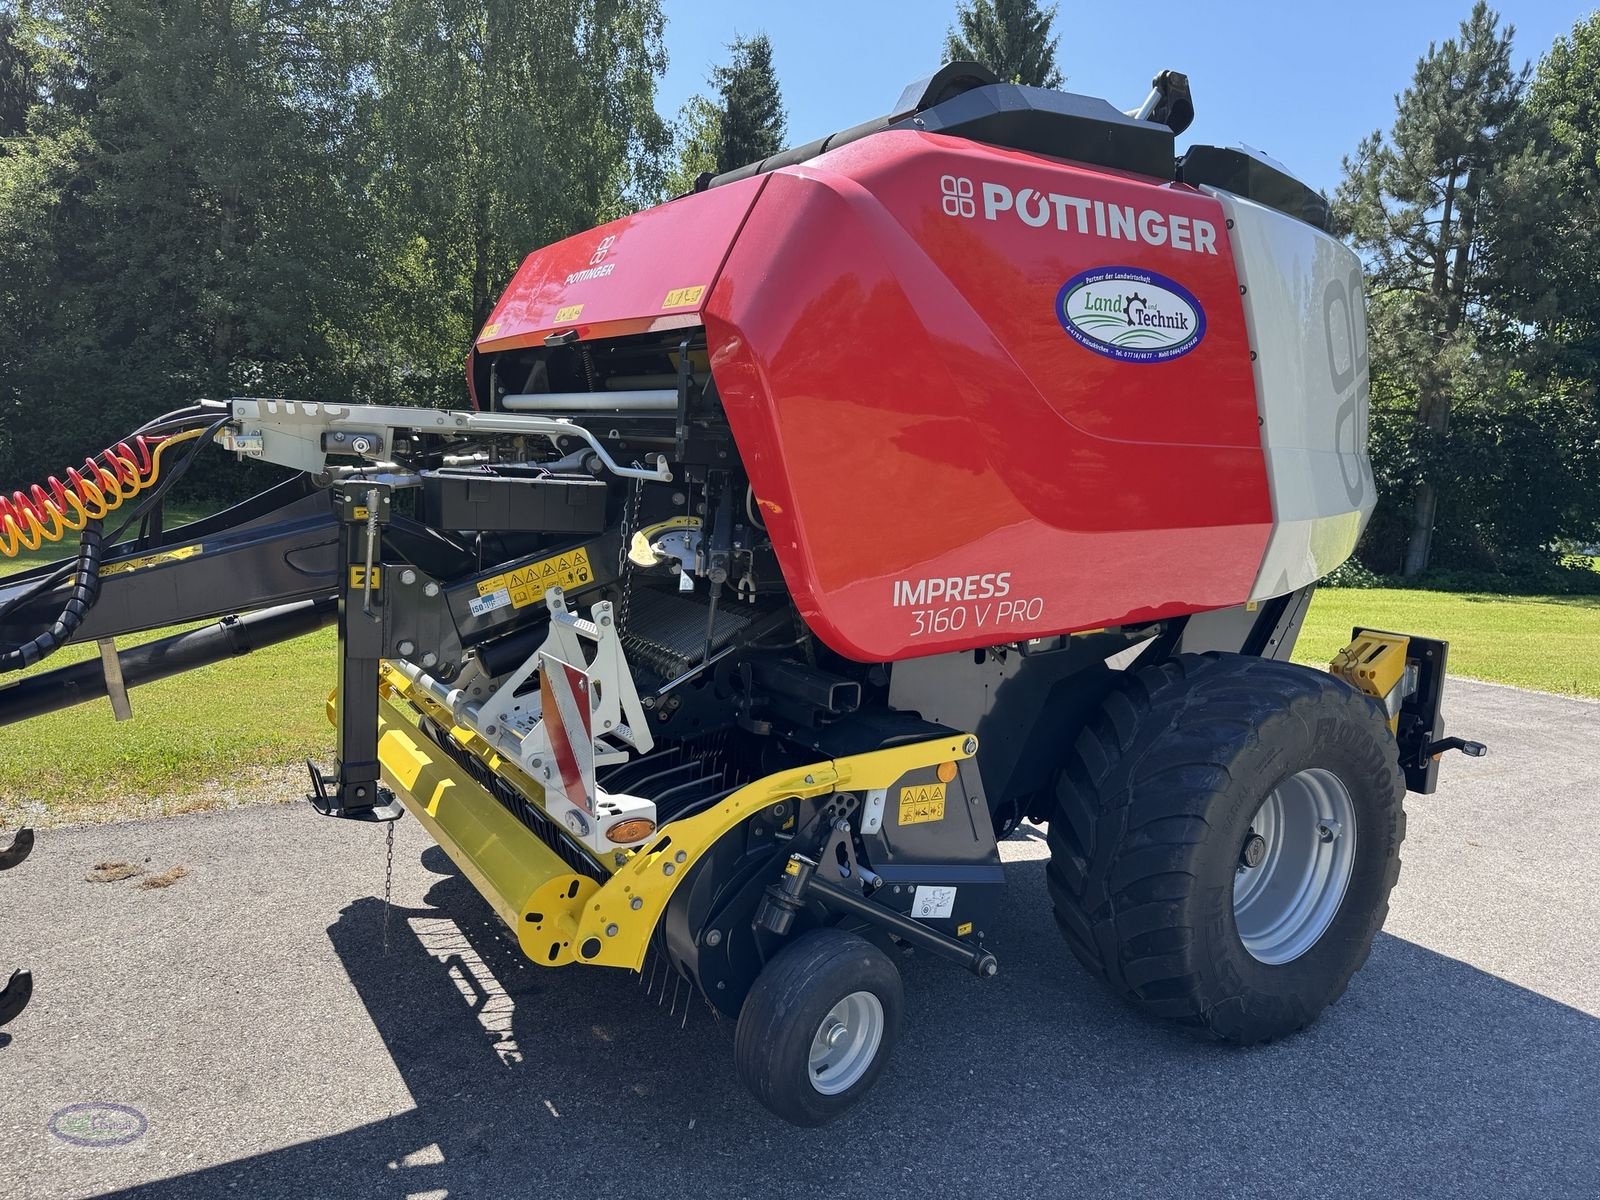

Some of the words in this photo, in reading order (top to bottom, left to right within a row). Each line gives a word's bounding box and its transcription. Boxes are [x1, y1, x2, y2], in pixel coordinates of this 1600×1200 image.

[982, 182, 1218, 255] PÖTTINGER
[1085, 274, 1104, 284] Partner
[1105, 272, 1114, 280] der
[1114, 272, 1152, 284] Landwirtschaft
[1084, 292, 1123, 313] Land
[1135, 308, 1189, 330] Technik
[892, 572, 1011, 607] IMPRESS
[910, 606, 966, 637] 3160
[974, 603, 992, 627] V
[995, 597, 1044, 625] PRO
